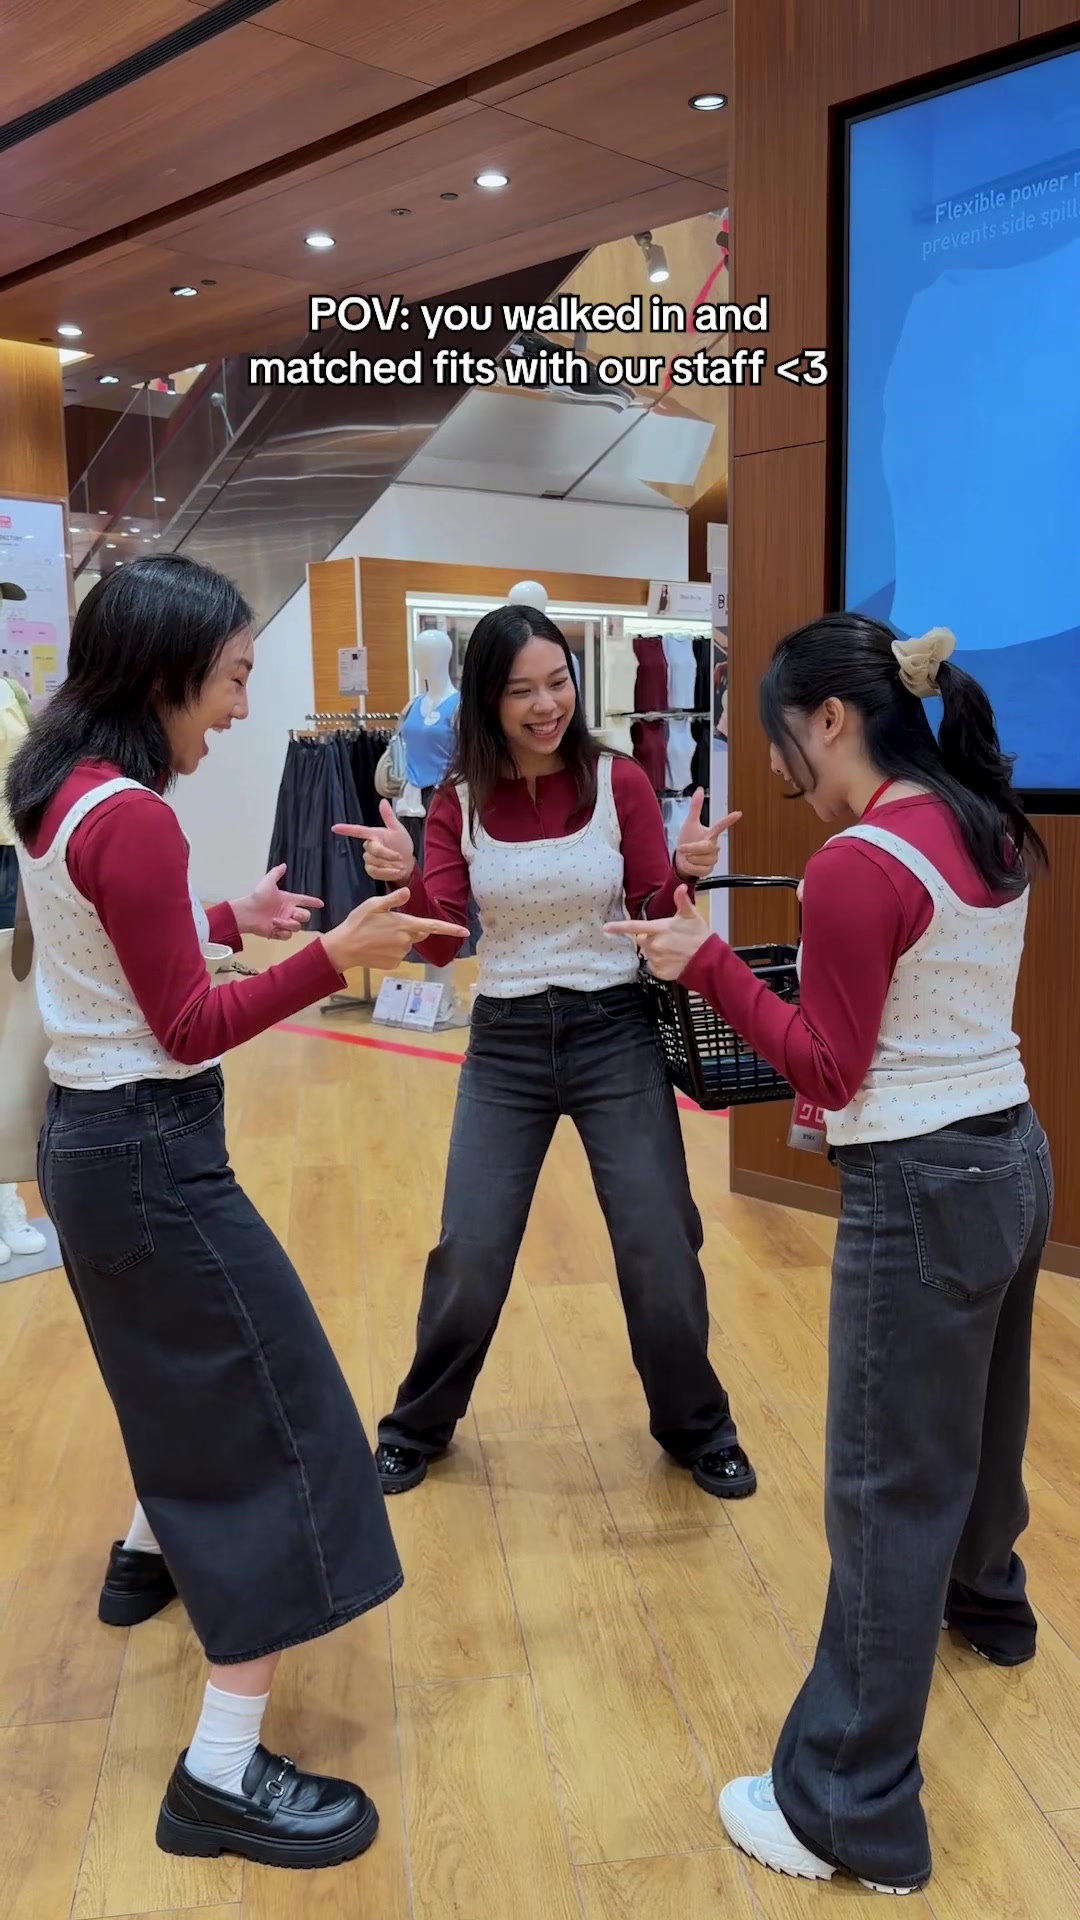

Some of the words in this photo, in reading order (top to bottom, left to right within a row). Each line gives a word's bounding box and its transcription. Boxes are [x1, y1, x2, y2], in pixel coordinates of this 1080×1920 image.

[935, 189, 1006, 225] Flexible
[1010, 175, 1069, 209] power
[922, 223, 997, 261] prevents
[1001, 214, 1036, 235] side
[1040, 198, 1080, 229] spill
